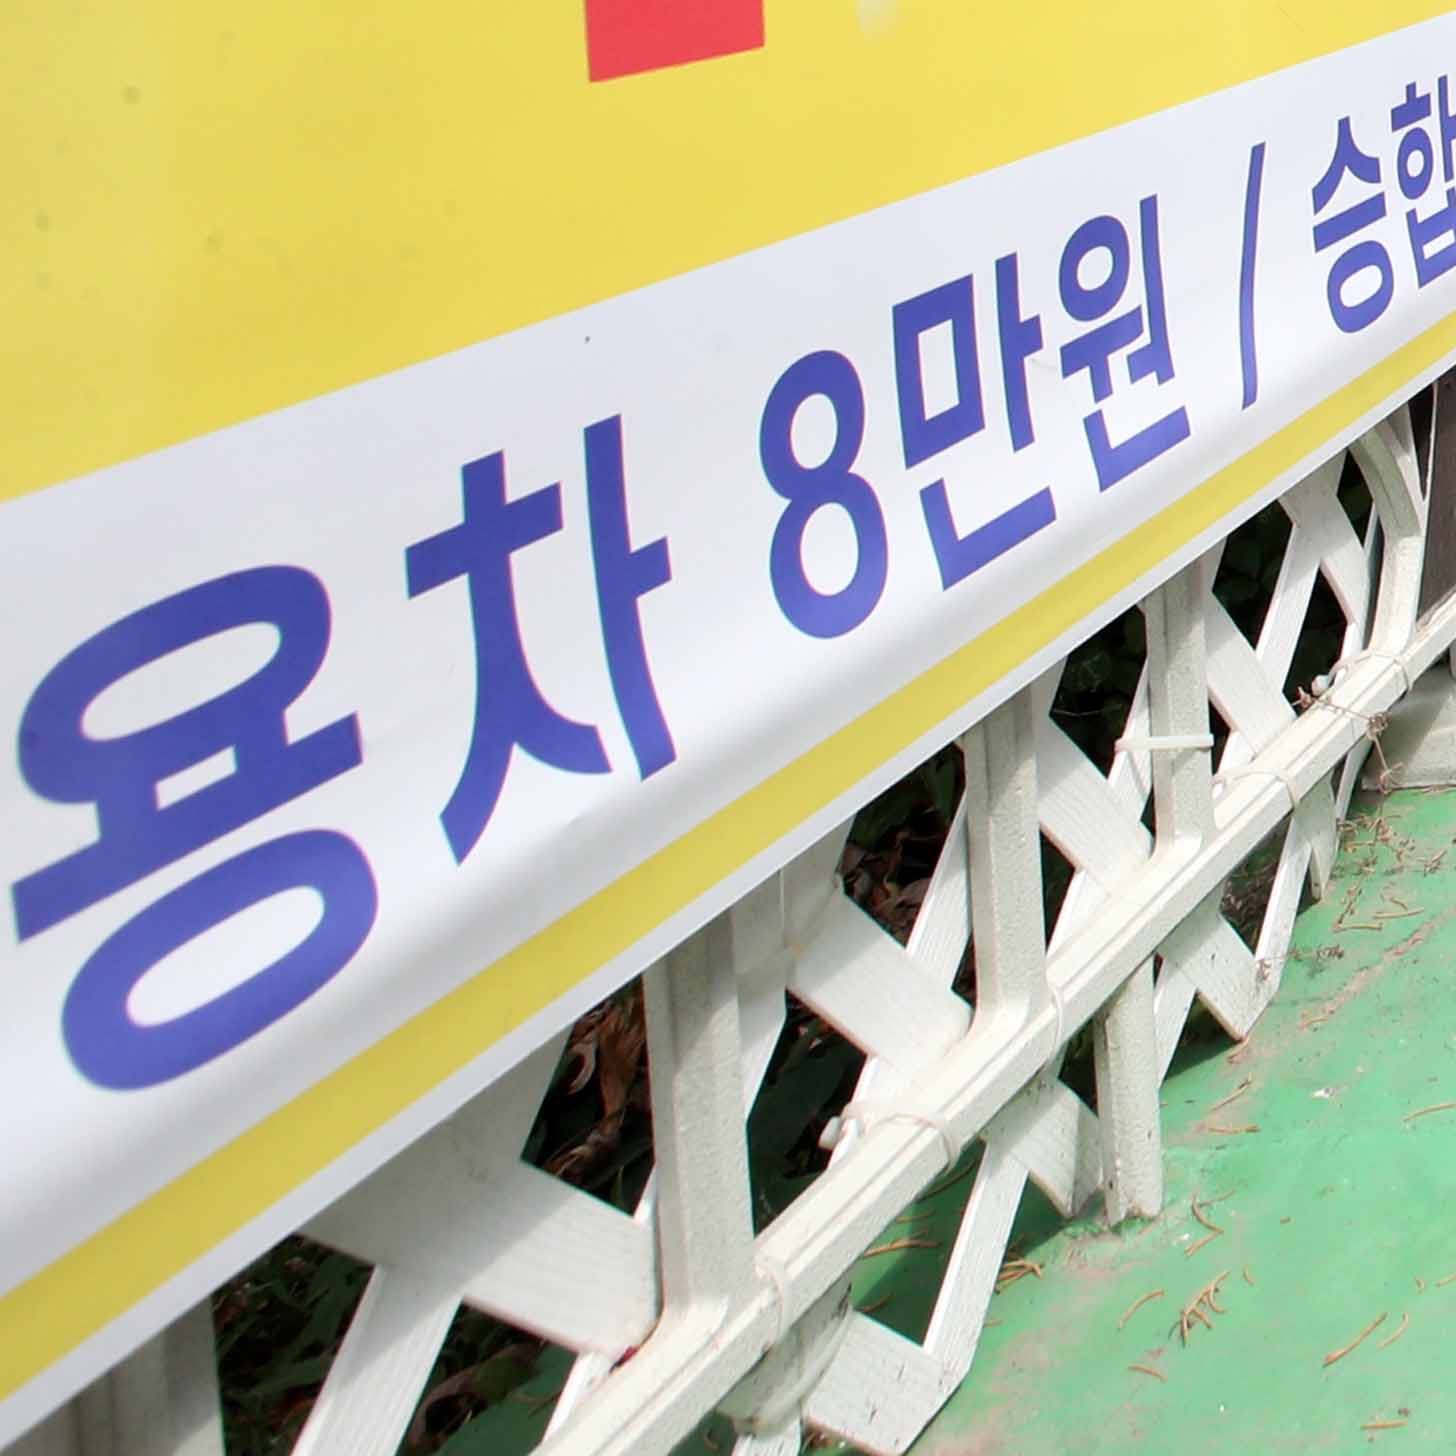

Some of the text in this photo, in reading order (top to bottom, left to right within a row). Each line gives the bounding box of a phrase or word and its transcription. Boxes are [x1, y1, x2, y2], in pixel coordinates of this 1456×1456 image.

[11, 412, 670, 1092] 용차
[758, 194, 1191, 641] 8만원
[1239, 141, 1266, 410] /
